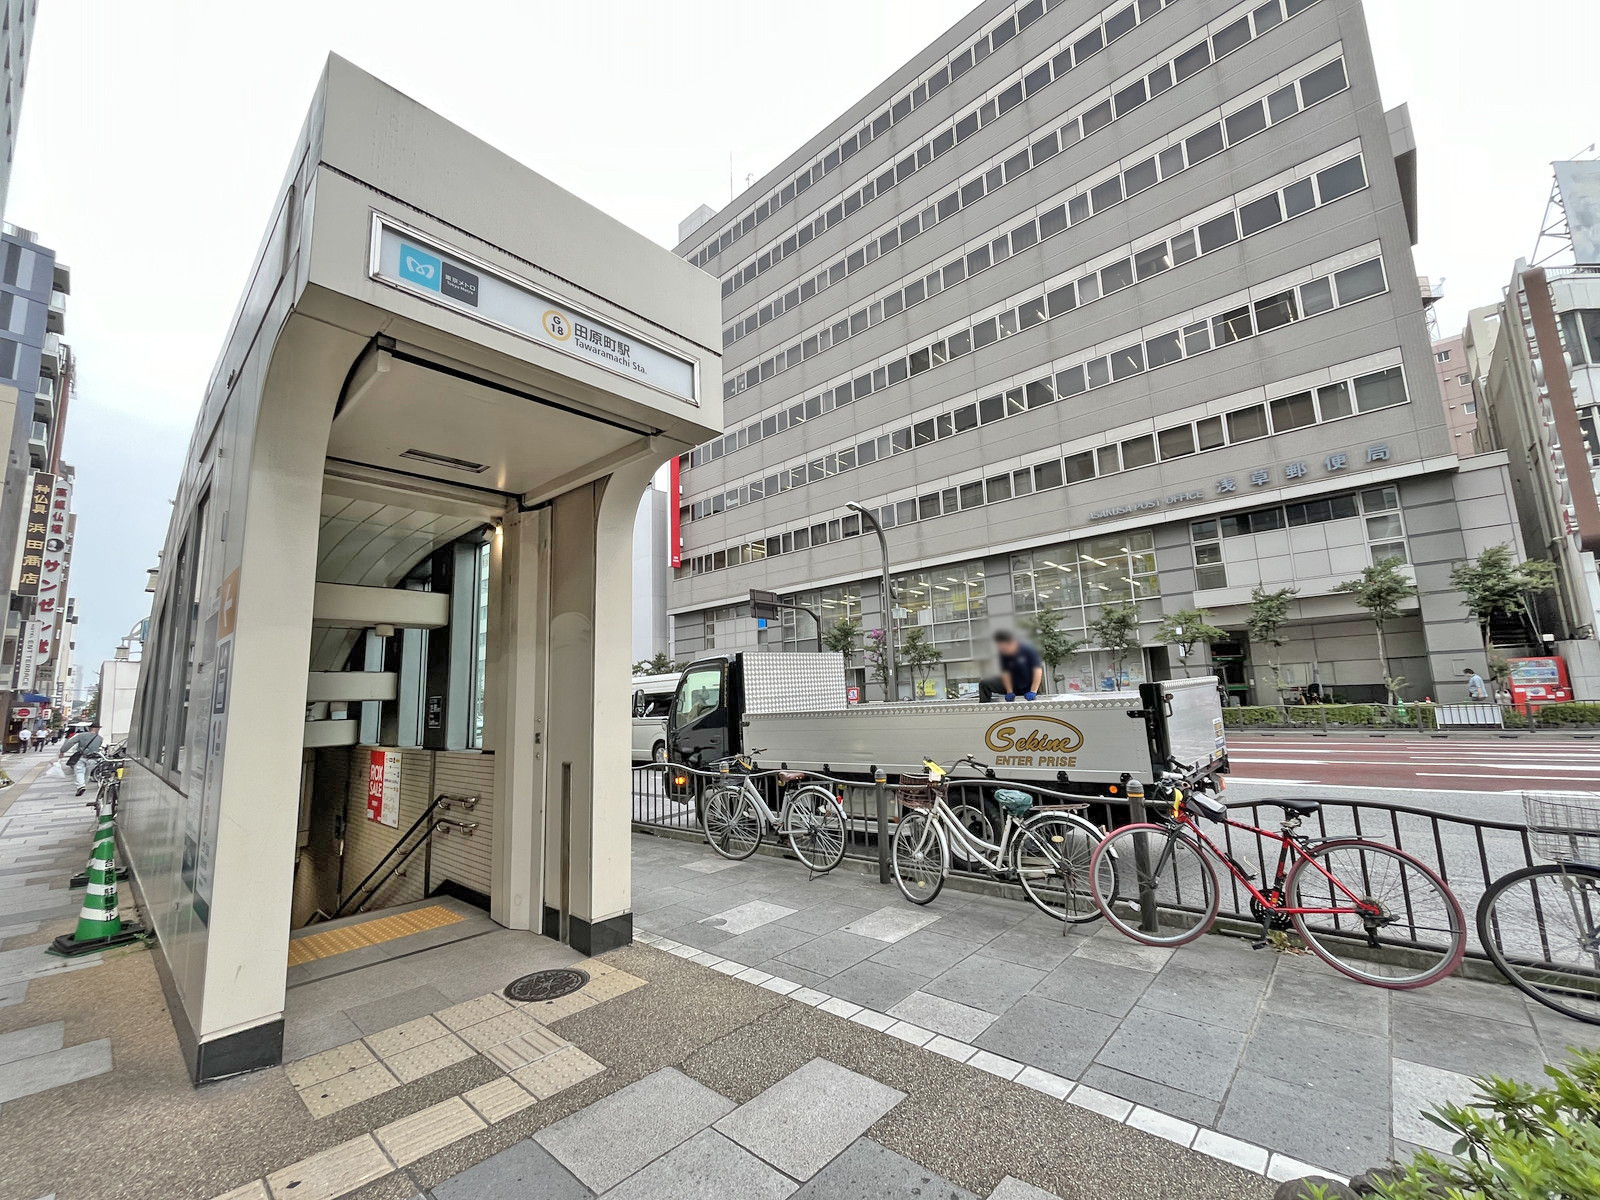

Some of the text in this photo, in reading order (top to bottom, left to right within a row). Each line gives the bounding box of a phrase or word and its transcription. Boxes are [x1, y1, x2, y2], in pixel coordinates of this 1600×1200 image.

[445, 274, 476, 292] 東京メトロ
[446, 280, 474, 295] Tokyo Metro
[550, 323, 564, 336] 18
[552, 315, 561, 325] G
[574, 322, 631, 358] 田原町駅
[574, 337, 648, 375] Tawaramachi Sta.
[1216, 444, 1391, 493] 浅草郵便局
[1088, 490, 1204, 520] ASAKUSA POST OFFICE
[20, 522, 46, 585] 浜田商店
[27, 639, 35, 653] ENT
[22, 655, 33, 687] TERRACE
[989, 725, 1074, 753] Sekine
[995, 755, 1077, 767] ENTER PRISE
[369, 781, 383, 797] SALE
